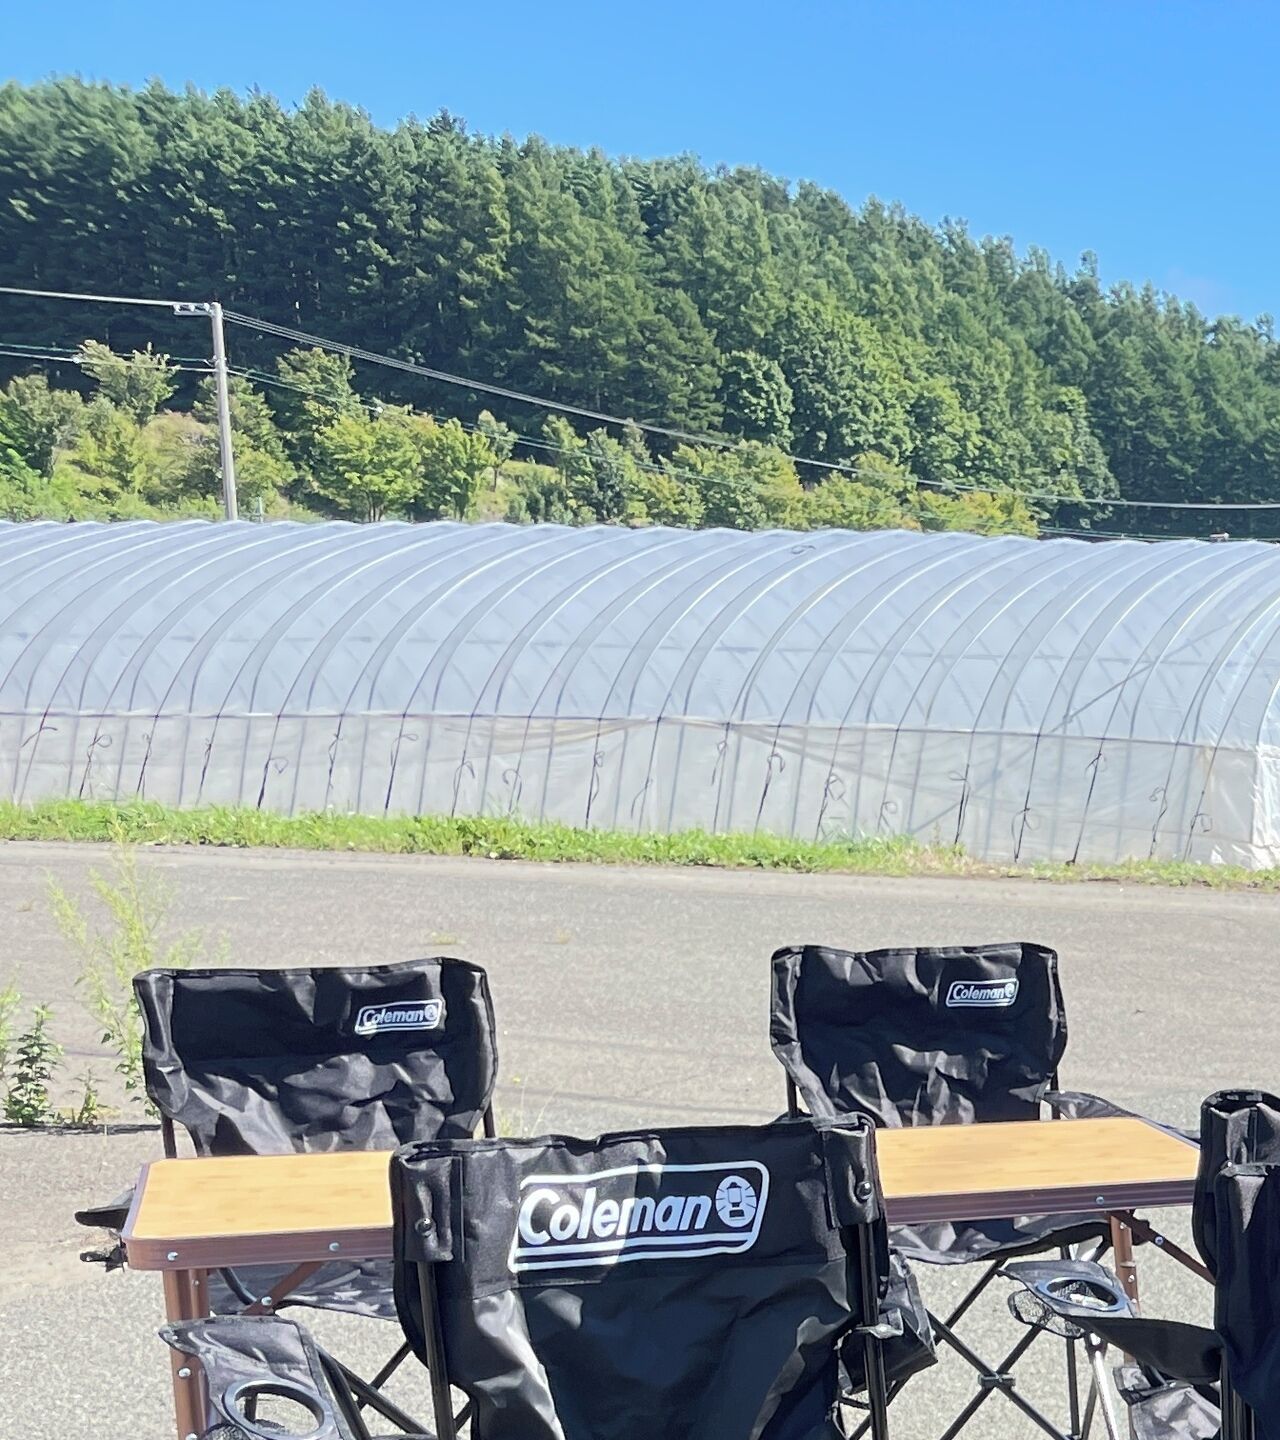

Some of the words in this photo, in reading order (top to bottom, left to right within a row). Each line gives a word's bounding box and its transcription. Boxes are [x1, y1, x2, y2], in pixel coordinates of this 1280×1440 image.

[953, 984, 1005, 1000] Coleman
[363, 1008, 424, 1026] Coleman
[518, 1186, 712, 1246] Coleman
